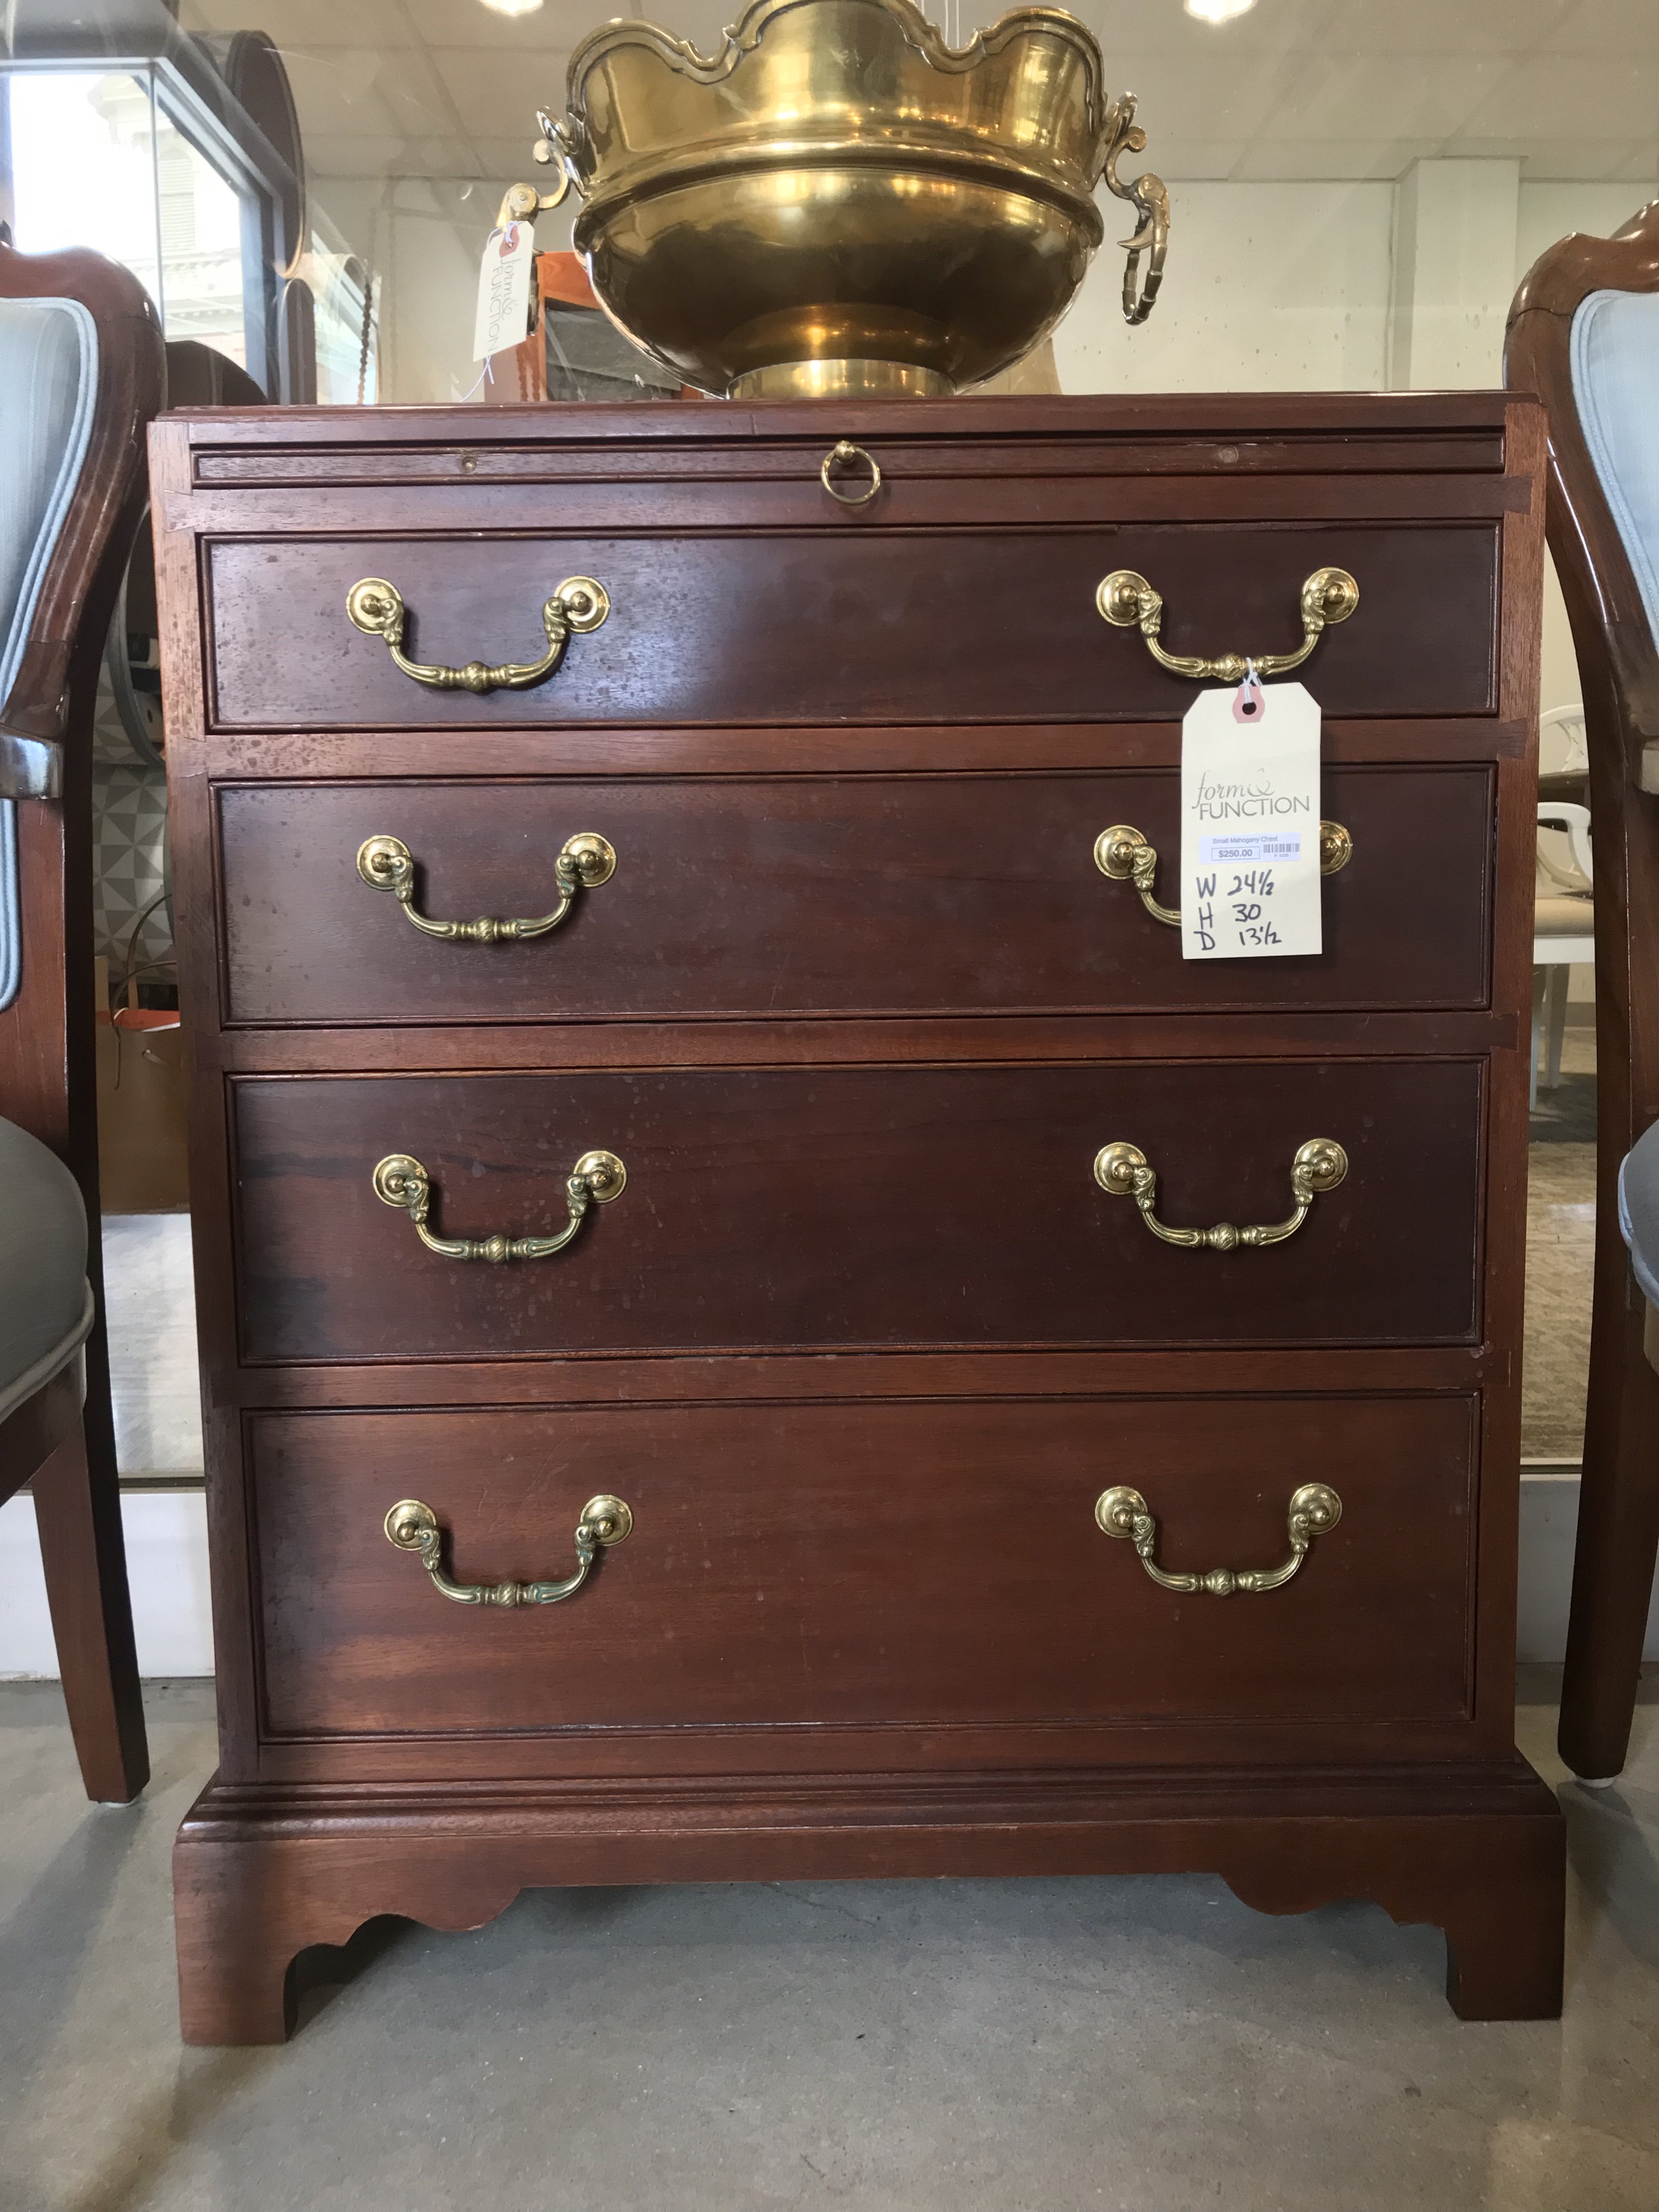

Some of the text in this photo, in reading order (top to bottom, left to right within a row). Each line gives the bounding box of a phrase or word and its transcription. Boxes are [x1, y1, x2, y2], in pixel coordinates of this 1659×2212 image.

[488, 266, 503, 352] FUNCTION
[1199, 795, 1310, 821] FUNCTION
[1218, 849, 1253, 858] $250.00
[1195, 873, 1216, 899] W
[1198, 901, 1261, 930] H 30
[1193, 930, 1216, 950] D
